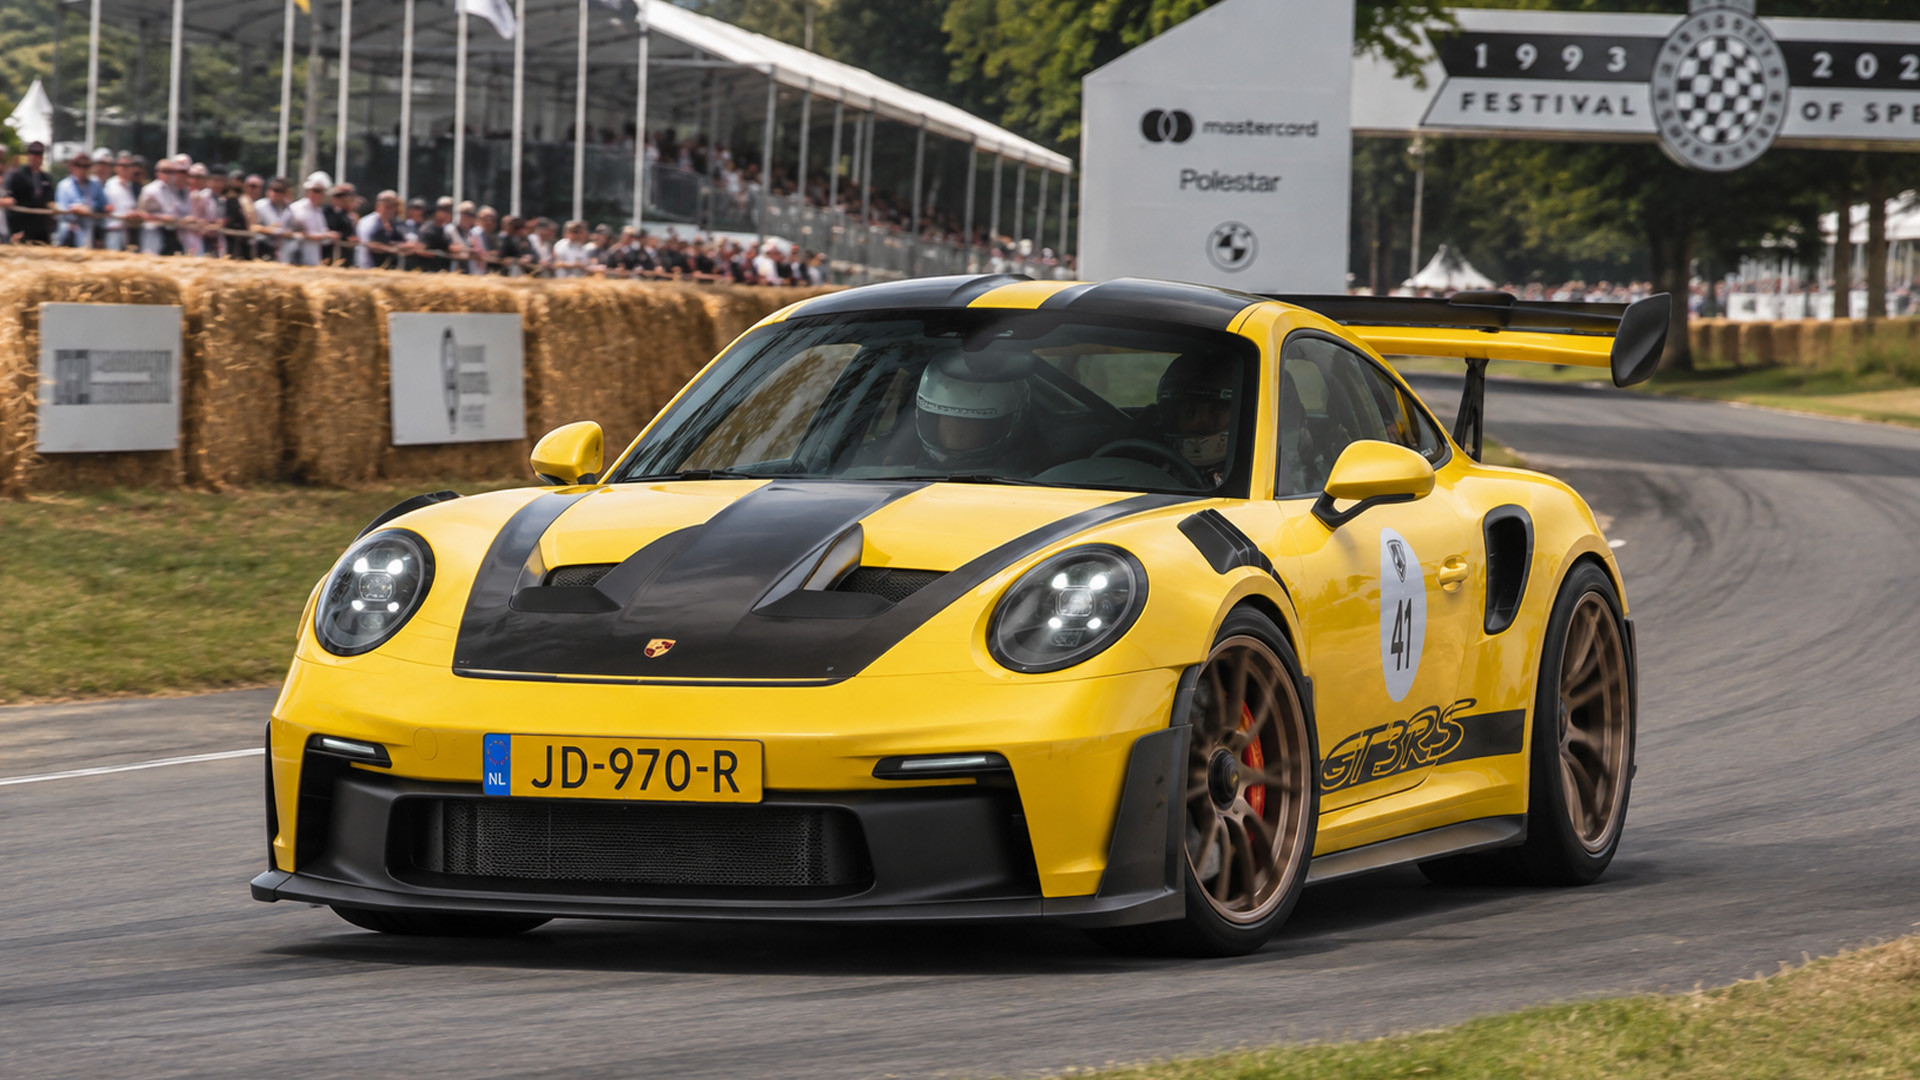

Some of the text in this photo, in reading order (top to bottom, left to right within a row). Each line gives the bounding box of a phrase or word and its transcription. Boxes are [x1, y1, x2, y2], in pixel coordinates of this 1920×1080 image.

[1474, 42, 1919, 80] 1993 202
[1460, 91, 1636, 116] FESTIVAL
[1801, 101, 1844, 121] OF
[1202, 120, 1319, 137] mastercard
[1179, 168, 1282, 192] Polestar
[1390, 598, 1412, 671] 41
[488, 772, 506, 785] NL
[531, 745, 740, 793] JD-970-R
